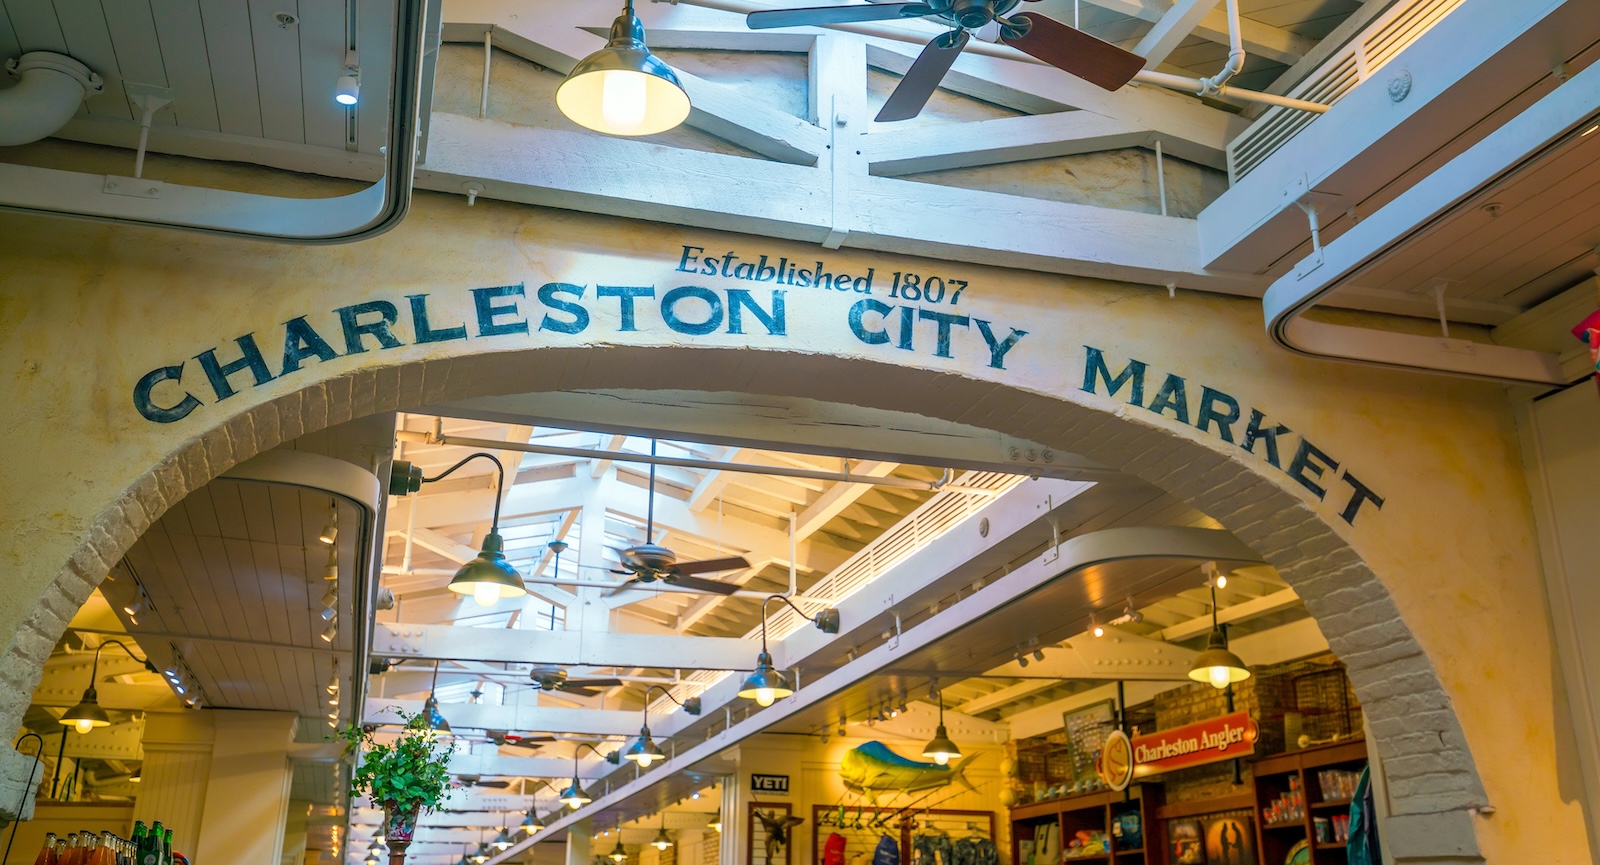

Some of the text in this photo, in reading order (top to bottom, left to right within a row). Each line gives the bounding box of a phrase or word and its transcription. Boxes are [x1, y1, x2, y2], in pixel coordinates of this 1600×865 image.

[675, 244, 969, 305] Established 1807
[132, 281, 1386, 527] CHARLESTON CITY MARKET
[1135, 724, 1244, 764] Charleston Angler
[752, 775, 787, 790] YETI
